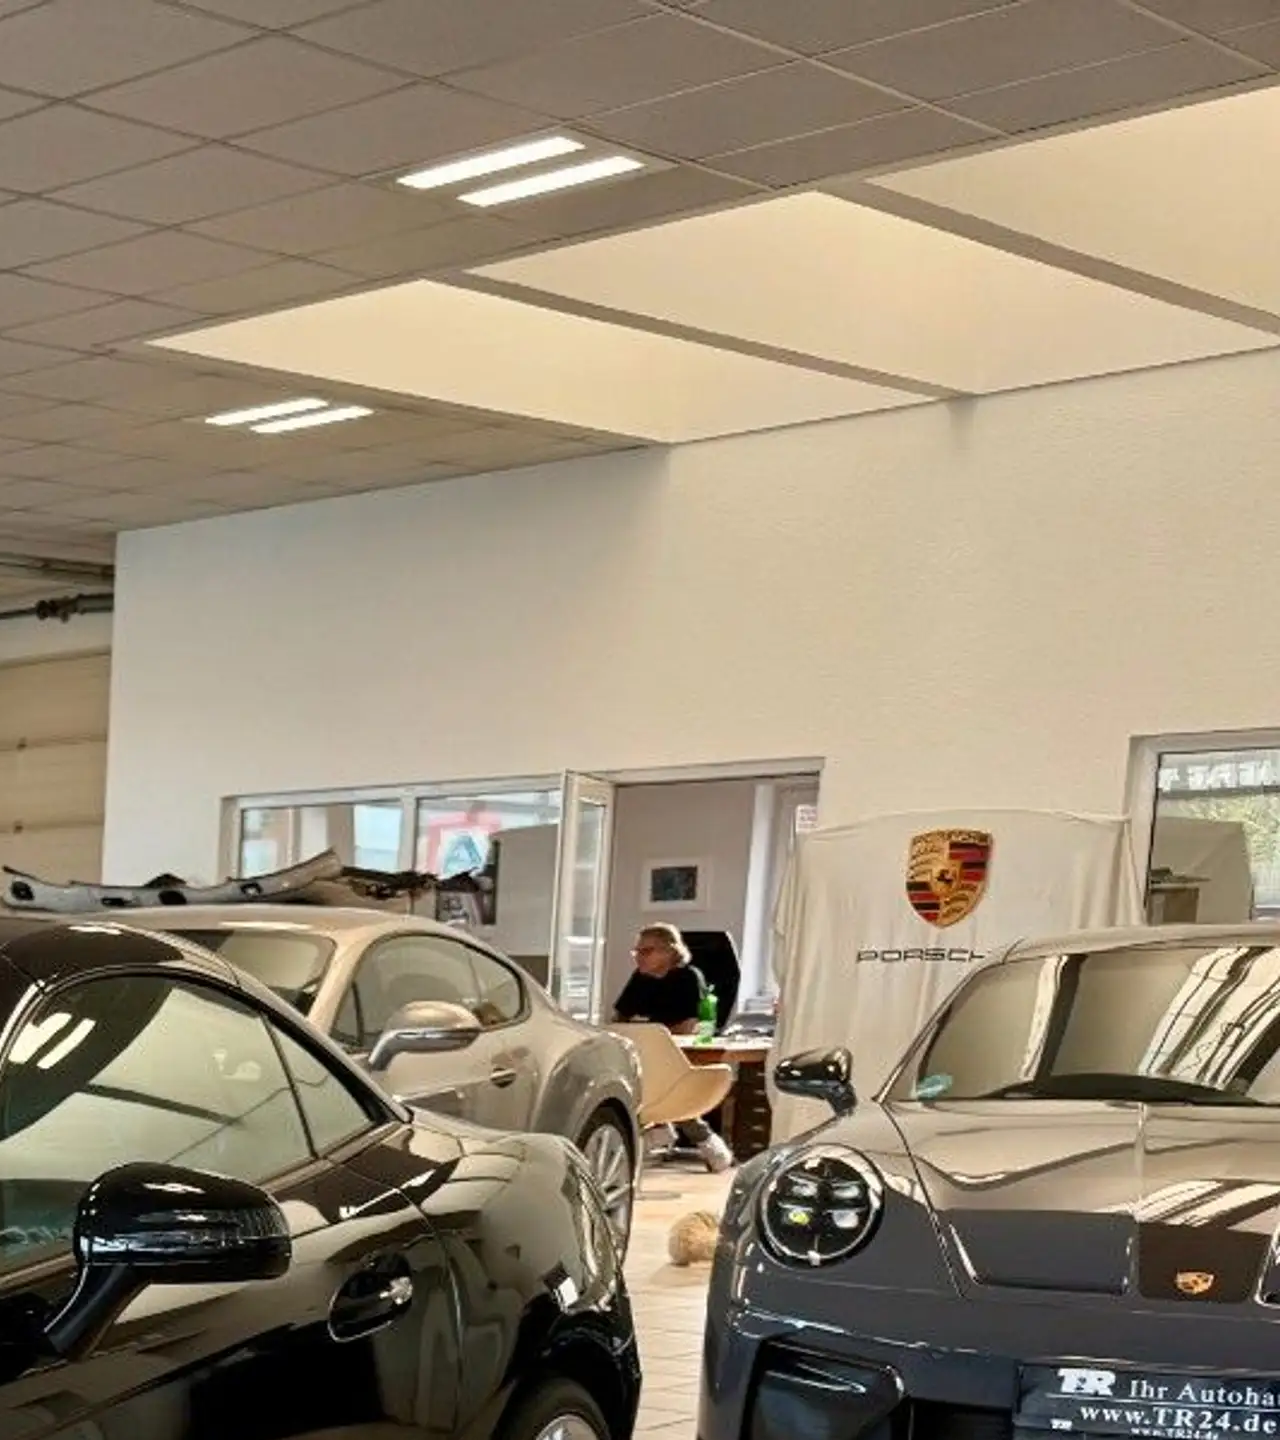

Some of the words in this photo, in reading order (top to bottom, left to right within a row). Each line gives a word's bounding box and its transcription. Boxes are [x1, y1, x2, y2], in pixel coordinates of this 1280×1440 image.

[856, 948, 986, 963] PORSCH
[1129, 1379, 1169, 1400] Ihr
[1080, 1405, 1277, 1434] www.TR24.de
